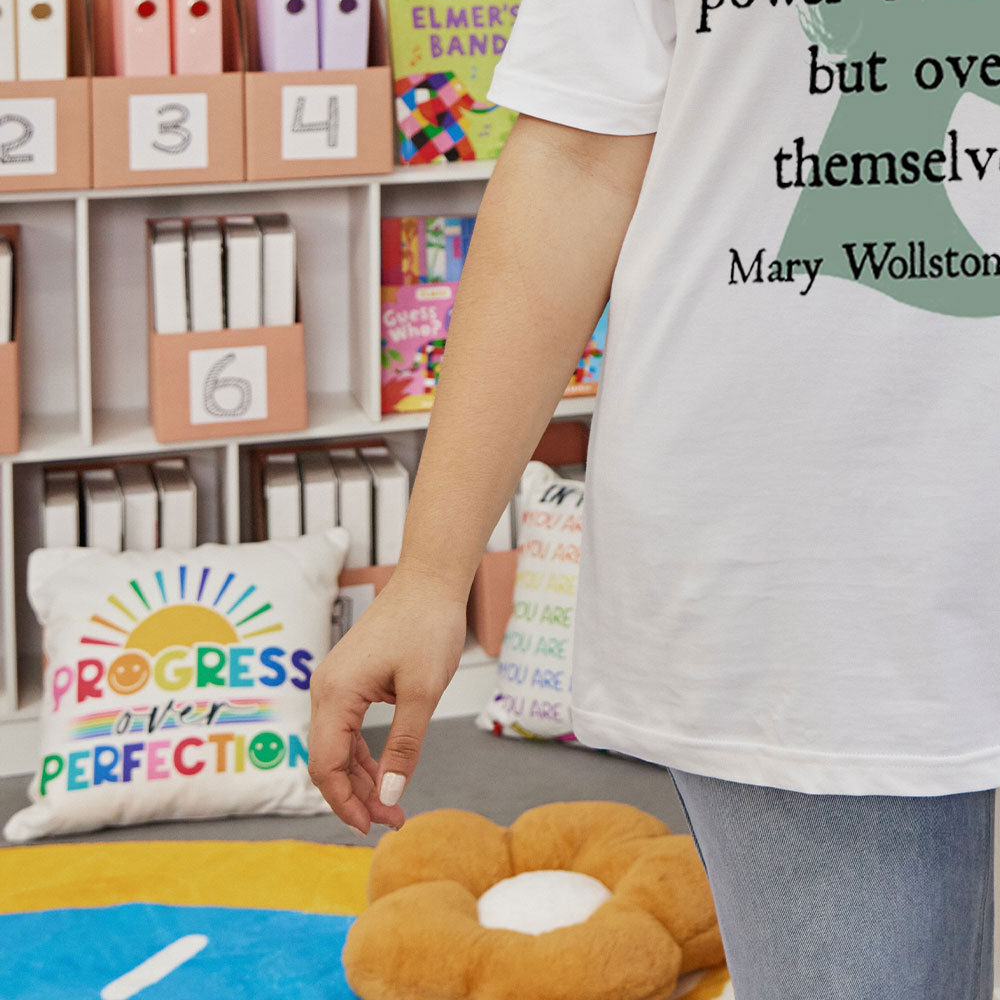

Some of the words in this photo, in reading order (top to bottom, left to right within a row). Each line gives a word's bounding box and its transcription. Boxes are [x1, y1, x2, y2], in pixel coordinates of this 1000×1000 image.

[429, 33, 509, 59] BAND
[807, 44, 888, 96] but
[0, 114, 35, 164] 2
[152, 102, 193, 156] 3
[291, 95, 340, 149] 4
[728, 247, 824, 297] Mary
[382, 306, 438, 328] Guess
[387, 319, 442, 343] Who?
[202, 352, 253, 418] 6
[541, 603, 573, 628] ARE
[535, 635, 568, 660] ARE
[52, 646, 314, 713] PROGRESS
[531, 665, 565, 692] ARE
[115, 699, 240, 734] over
[529, 697, 563, 722] ARE
[39, 731, 309, 796] PERFECTION
